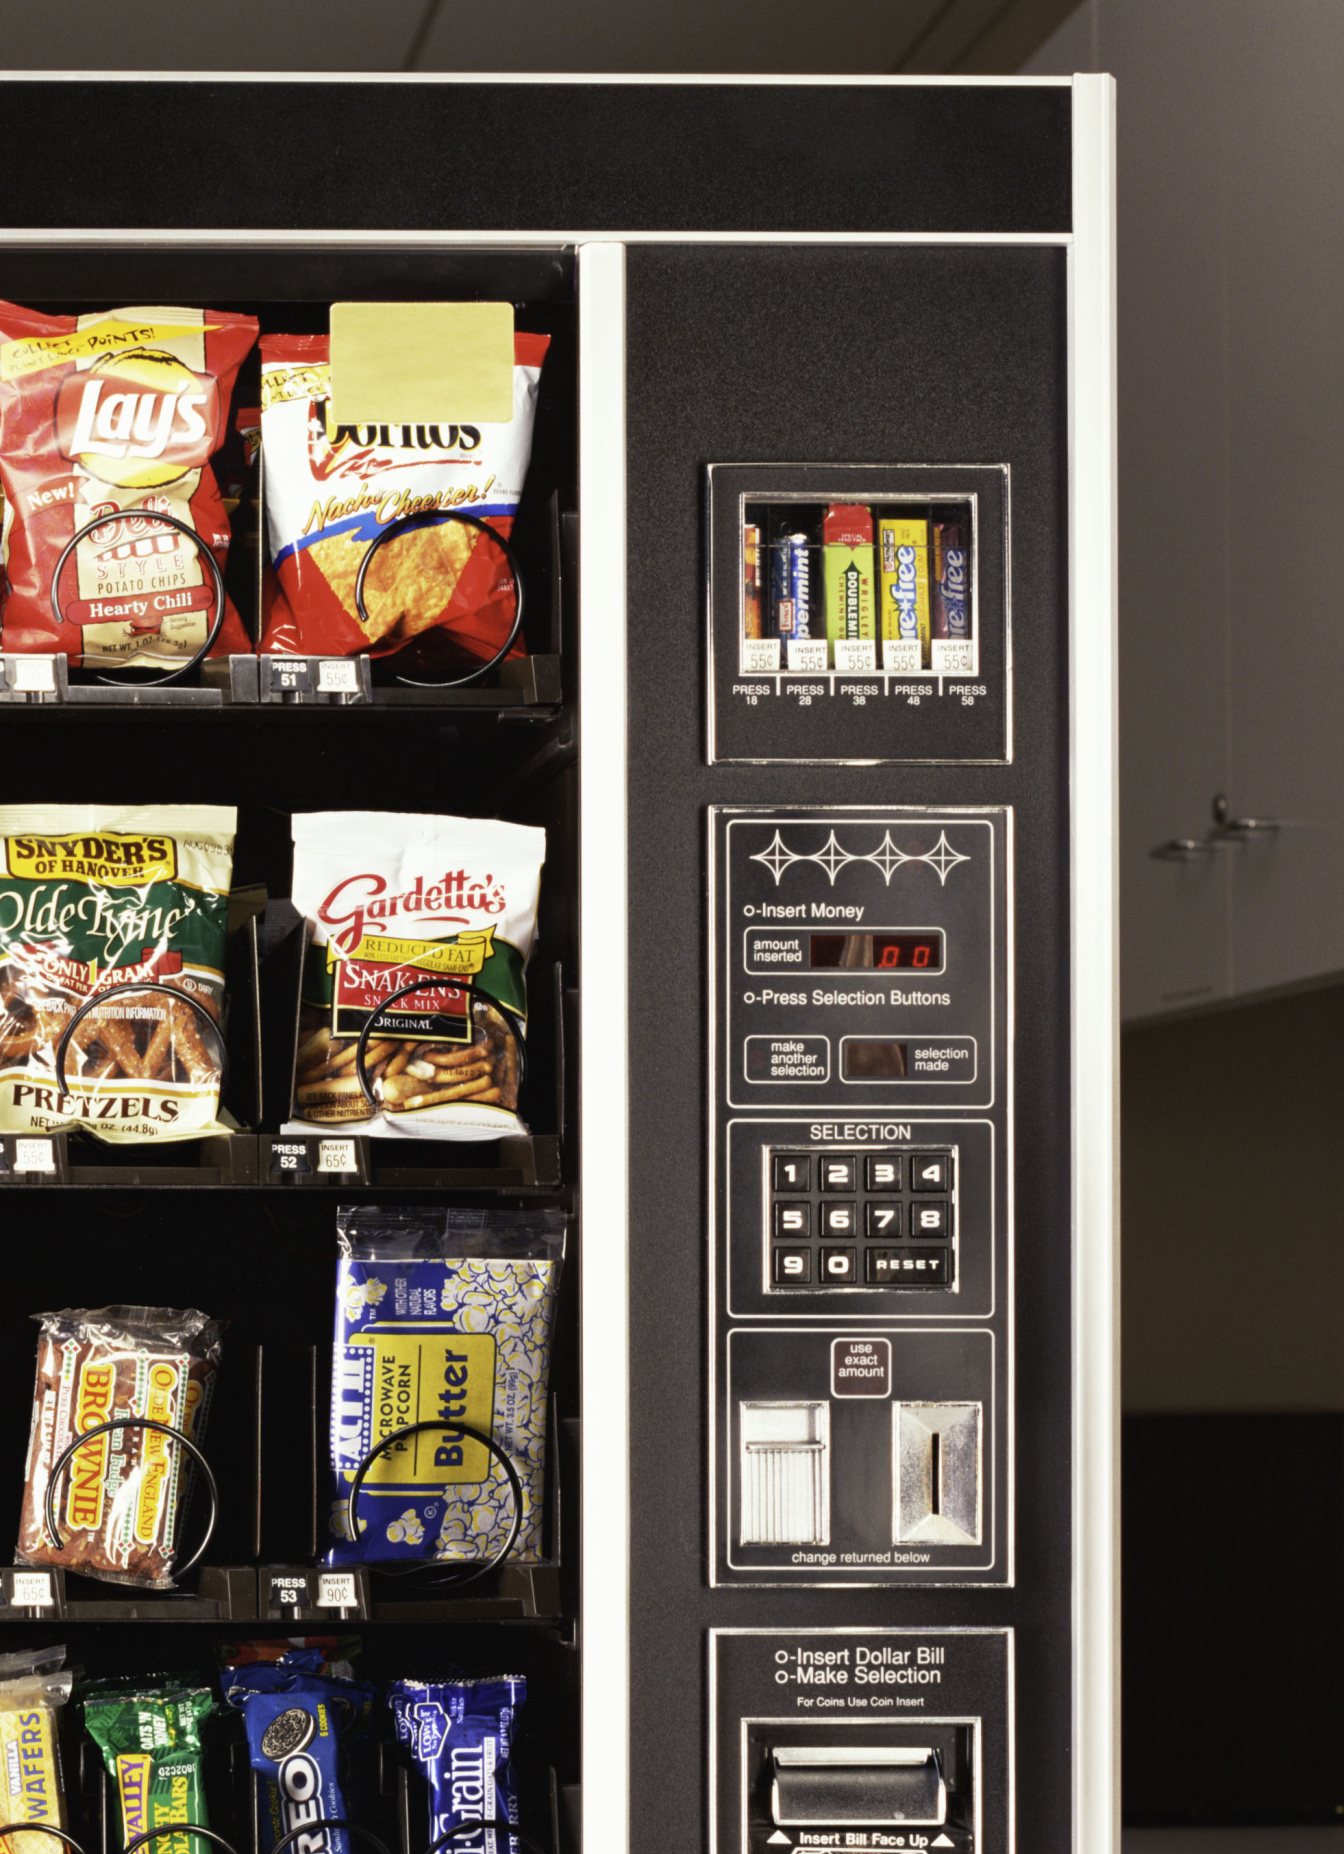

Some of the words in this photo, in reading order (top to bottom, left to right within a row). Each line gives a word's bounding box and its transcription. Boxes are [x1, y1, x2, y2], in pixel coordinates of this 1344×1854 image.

[69, 380, 206, 459] Lay's
[26, 482, 74, 510] New!
[302, 483, 383, 535] Nacho
[376, 475, 496, 524] Cheesier!
[97, 554, 184, 579] STYLE
[97, 580, 144, 595] POTATO
[151, 573, 186, 589] CHIPS
[89, 600, 148, 618] Hearty
[153, 592, 193, 611] Chili
[733, 685, 770, 695] PRESS
[841, 685, 878, 695] PRESS
[949, 686, 986, 695] PRESS
[746, 696, 757, 705] 18
[853, 696, 866, 705] 38
[962, 696, 974, 705] 58
[317, 869, 506, 956] Gardetto's
[811, 903, 864, 921] Money
[364, 938, 443, 963] REDUCED
[447, 948, 475, 964] FAT
[754, 939, 799, 950] amount
[754, 950, 802, 962] inserted
[812, 990, 885, 1005] Selection
[891, 990, 950, 1005] Buttons
[771, 1041, 804, 1052] make
[915, 1048, 968, 1059] selection
[771, 1053, 817, 1064] another
[915, 1059, 949, 1071] made
[771, 1064, 824, 1076] selection
[811, 1125, 910, 1140] SELECTION
[785, 1165, 795, 1182] 1
[829, 1165, 848, 1182] 2
[875, 1165, 894, 1182] 3
[922, 1165, 940, 1182] 4
[783, 1211, 802, 1228] 5
[830, 1210, 849, 1228] 6
[875, 1210, 894, 1227] 7
[921, 1211, 940, 1227] 8
[784, 1257, 803, 1273] 9
[828, 1256, 849, 1273] 0
[877, 1260, 939, 1269] RESET
[850, 1344, 872, 1353] use
[845, 1355, 878, 1365] exact
[839, 1367, 884, 1377] amount
[434, 1348, 468, 1467] Butter
[72, 1369, 111, 1526] BROWNIE
[791, 1551, 837, 1565] change
[841, 1551, 891, 1563] returned
[894, 1552, 930, 1563] below
[272, 1578, 306, 1588] PRESS
[322, 1577, 350, 1585] INSERT
[281, 1590, 297, 1602] 53
[327, 1587, 347, 1601] 90¢
[856, 1647, 911, 1664] Dollar
[917, 1647, 944, 1664] Bill
[855, 1666, 940, 1684] Selection
[797, 1697, 814, 1707] For
[816, 1697, 845, 1707] Coins
[848, 1697, 867, 1706] Use
[870, 1697, 893, 1706] Coin
[896, 1697, 924, 1706] Insert
[7, 1740, 21, 1795] VANILLA
[19, 1712, 48, 1820] WAFERS
[800, 1832, 840, 1845] Insert
[846, 1833, 868, 1845] Bill
[871, 1833, 905, 1846] Face
[909, 1834, 928, 1848] Up
